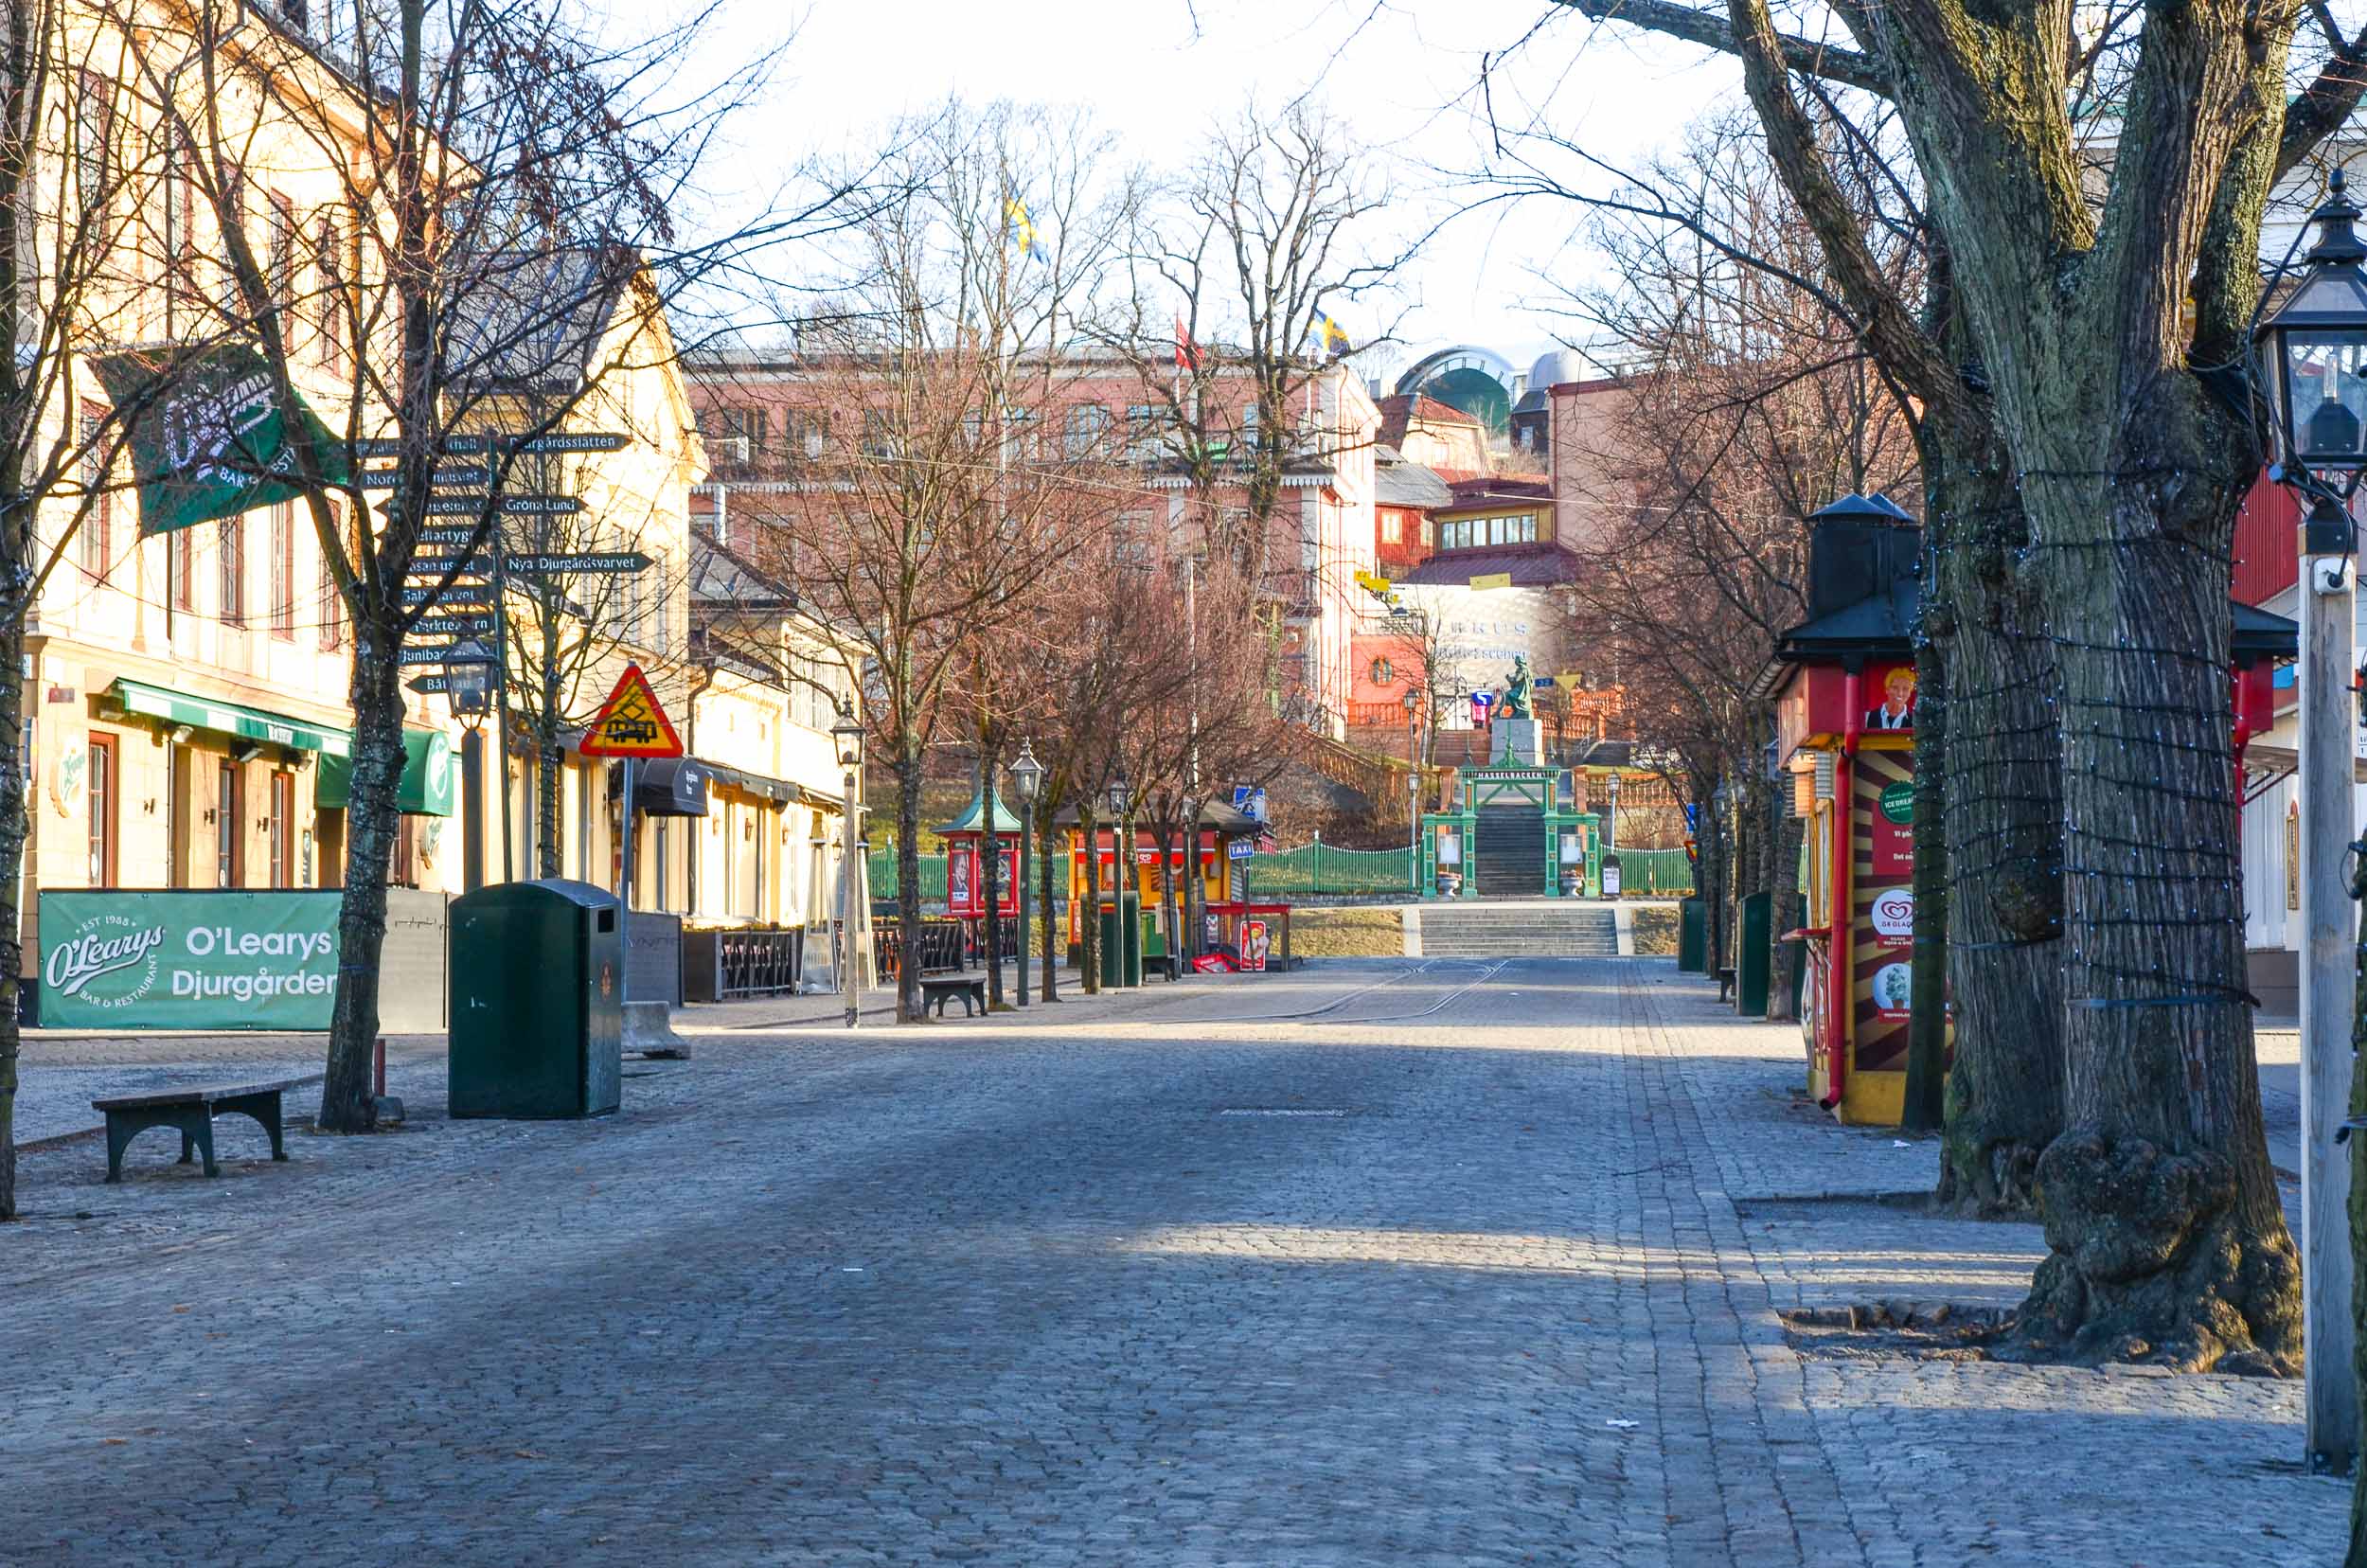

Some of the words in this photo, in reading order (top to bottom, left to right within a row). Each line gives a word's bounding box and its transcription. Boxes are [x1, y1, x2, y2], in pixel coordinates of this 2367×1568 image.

[506, 499, 543, 511] Gröna
[545, 502, 575, 511] Lund
[508, 559, 533, 572] Nya
[539, 557, 636, 572] Djurgårdsvarvet
[1231, 845, 1251, 855] TAXI
[81, 917, 101, 932] EST
[105, 915, 129, 927] 1988
[186, 926, 331, 960] O'Learys
[45, 924, 165, 989] O'Learys
[79, 988, 100, 1007] BAR
[115, 953, 157, 1007] RESTAURANT
